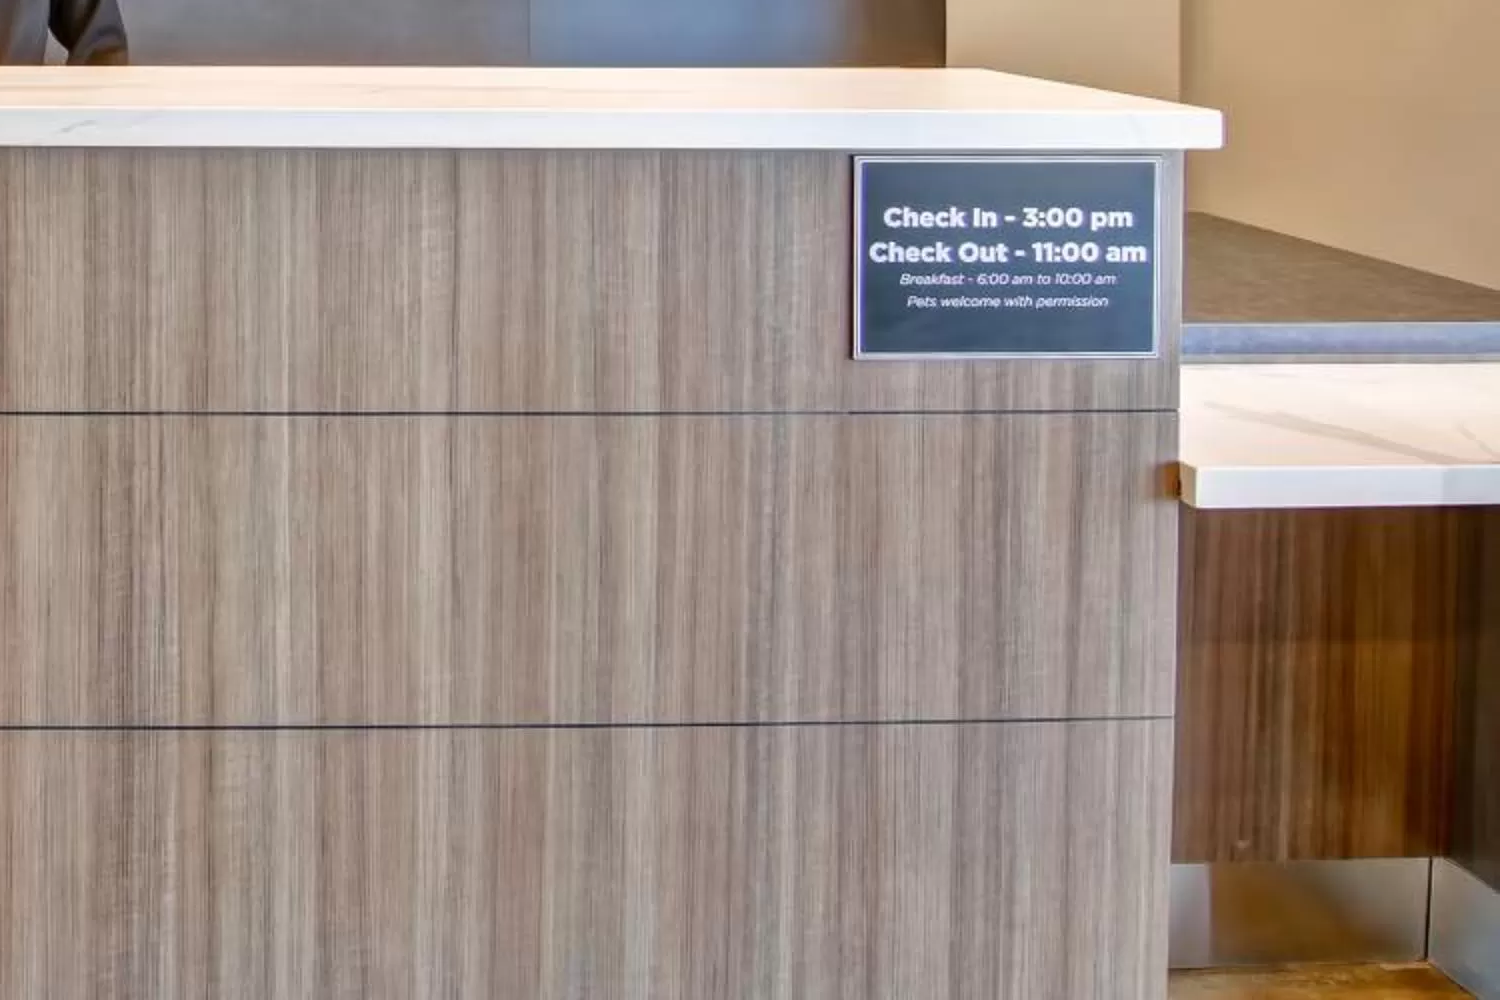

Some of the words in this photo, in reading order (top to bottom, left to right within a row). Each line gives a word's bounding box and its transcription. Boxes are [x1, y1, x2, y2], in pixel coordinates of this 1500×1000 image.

[883, 206, 967, 228] Check
[972, 207, 998, 228] In
[1022, 207, 1085, 228] 3:00
[1090, 211, 1134, 232] pm
[869, 241, 952, 263] Check
[957, 241, 1009, 263] Out
[1031, 241, 1100, 263] 11:00
[1105, 245, 1148, 263] am
[899, 273, 965, 285] Breakfast
[976, 273, 1010, 285] 6:00
[1011, 275, 1034, 285] am
[1036, 274, 1052, 285] to
[1055, 273, 1093, 285] 10:00
[1093, 275, 1117, 285] am
[907, 295, 937, 307] Pets
[940, 295, 1001, 308] welcome
[1003, 295, 1033, 307] with
[1035, 295, 1109, 309] permission
